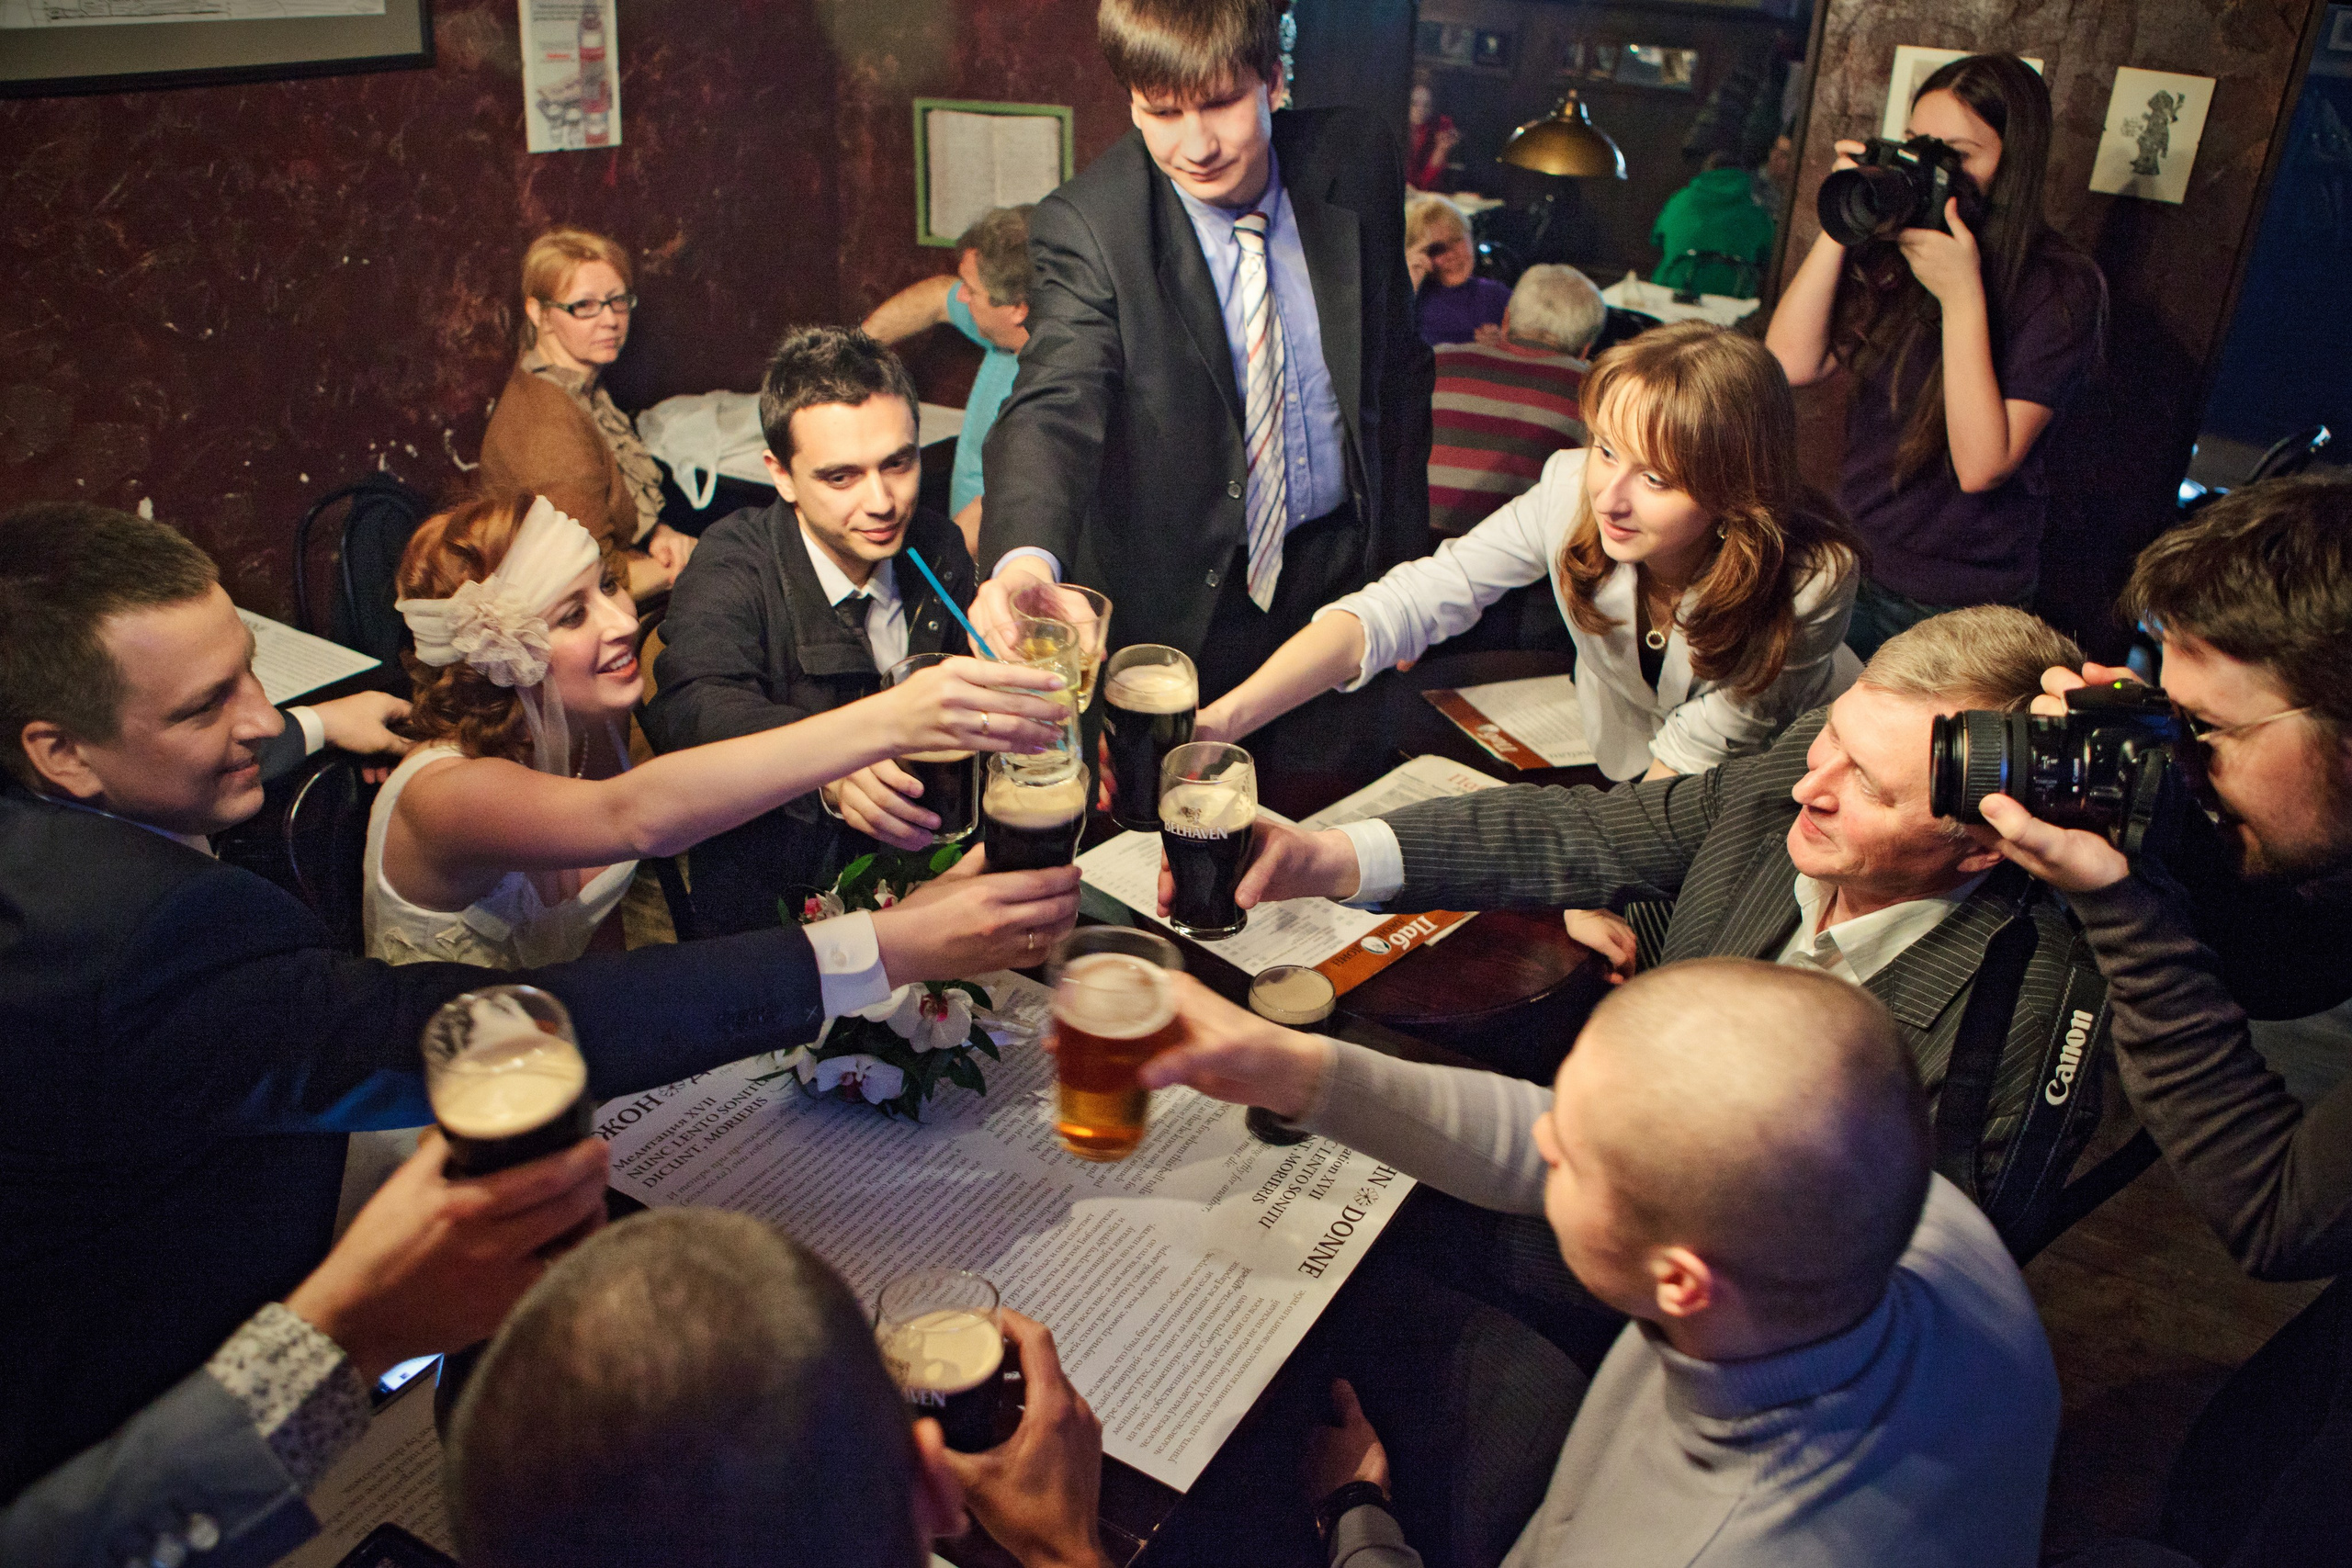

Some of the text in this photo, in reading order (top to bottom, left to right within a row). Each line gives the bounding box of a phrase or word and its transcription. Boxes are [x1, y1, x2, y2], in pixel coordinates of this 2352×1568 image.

[1164, 818, 1228, 840] BELHAVEN
[1388, 915, 1439, 951] Паб
[2045, 1010, 2094, 1106] Canon
[590, 1092, 665, 1142] ЖОН
[610, 1096, 718, 1172] Медитация XVII
[626, 1145, 676, 1180] NUNC
[670, 1111, 722, 1147] LENTO
[715, 1076, 771, 1115] SONITU
[640, 1095, 770, 1190] DICUNT, MORIERIS
[1232, 1140, 1251, 1157] must
[1137, 1116, 1218, 1197] be for whom this bell tolls
[1224, 1171, 1243, 1186] for
[1232, 1154, 1259, 1177] softly
[1250, 1151, 1302, 1205] MORIERIS
[1292, 1146, 1331, 1185] LENTO
[1306, 1174, 1336, 1201] XVII
[1256, 1182, 1302, 1229] SONITU
[1296, 1202, 1367, 1280] DONNE
[1056, 1340, 1081, 1363] своей
[1078, 1321, 1100, 1342] стоит
[1097, 1306, 1114, 1322] уже
[1110, 1286, 1131, 1307] почти
[1129, 1262, 1151, 1283] самой
[1069, 1359, 1083, 1372] его
[1080, 1336, 1106, 1361] звучит
[1125, 1295, 1140, 1309] чем
[1136, 1285, 1150, 1297] для
[1107, 1354, 1145, 1393] живущий
[1142, 1333, 1161, 1353] часть
[1198, 1270, 1214, 1286] если
[1114, 1350, 1128, 1364] что
[1122, 1335, 1140, 1351] был
[1147, 1312, 1161, 1326] сам
[1180, 1274, 1193, 1287] как
[1115, 1382, 1138, 1407] смоет
[1157, 1332, 1181, 1357] станет
[1184, 1295, 1210, 1324] меньше
[1207, 1283, 1220, 1296] вся
[1247, 1327, 1258, 1337] не
[1251, 1298, 1280, 1328] посылай
[1112, 1403, 1141, 1434] меньше
[1140, 1388, 1152, 1400] на
[1148, 1350, 1185, 1391] каменную
[1196, 1320, 1208, 1331] на
[1204, 1289, 1234, 1322] поместье
[1125, 1430, 1137, 1441] на
[1131, 1410, 1152, 1432] твой
[1146, 1361, 1192, 1413] собственный
[1197, 1320, 1228, 1350] Смерть
[1222, 1293, 1249, 1323] каждого
[1139, 1413, 1171, 1449] человека
[1167, 1382, 1197, 1416] умаляет
[1209, 1341, 1227, 1359] ибо
[1227, 1321, 1246, 1340] един
[1240, 1312, 1251, 1323] со
[1247, 1296, 1264, 1314] всем
[1189, 1424, 1201, 1436] по
[1197, 1408, 1214, 1425] ком
[1209, 1382, 1233, 1409] звонит
[1252, 1343, 1264, 1354] он
[1260, 1319, 1282, 1344] звонит
[1283, 1304, 1294, 1315] по
[1204, 1364, 1231, 1393] потому
[1225, 1337, 1251, 1367] никогда
